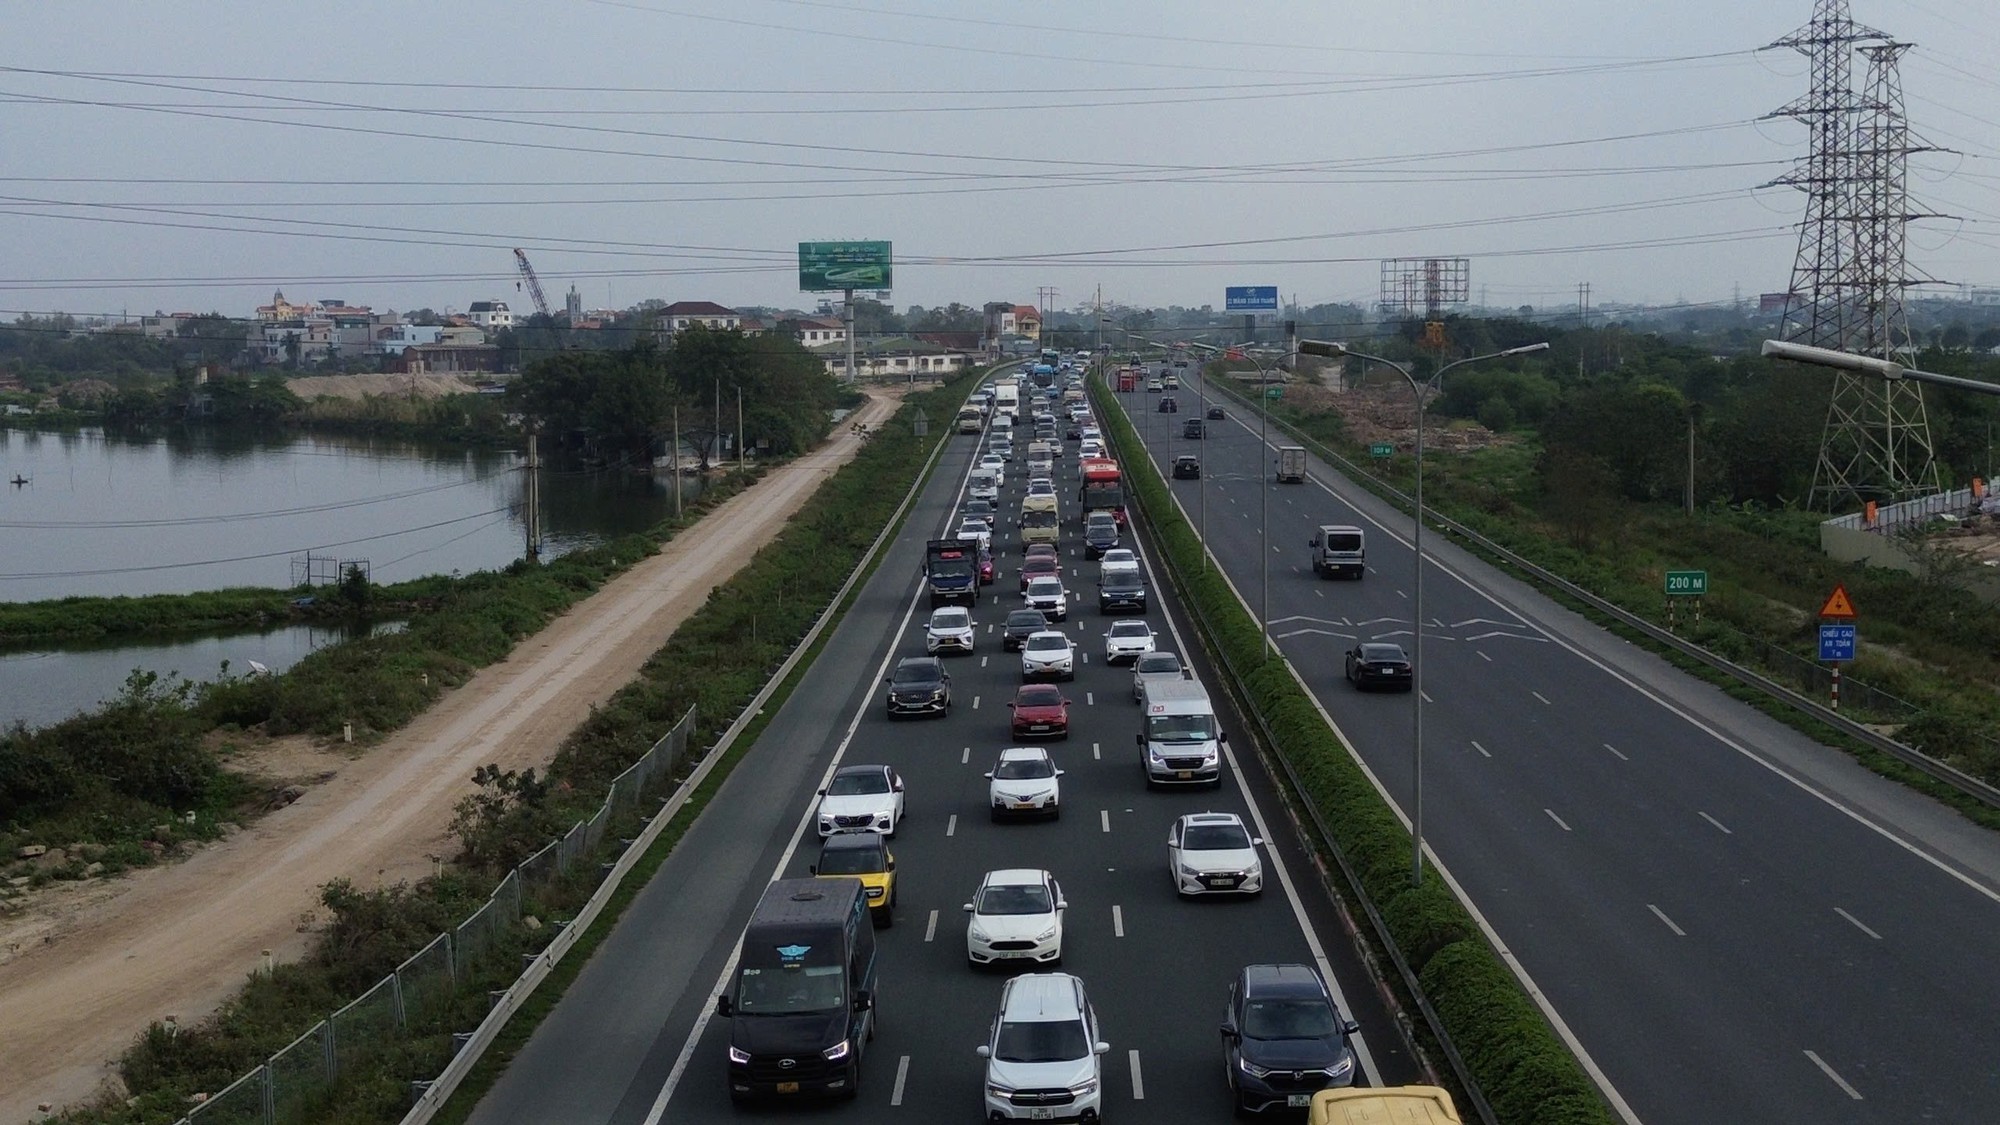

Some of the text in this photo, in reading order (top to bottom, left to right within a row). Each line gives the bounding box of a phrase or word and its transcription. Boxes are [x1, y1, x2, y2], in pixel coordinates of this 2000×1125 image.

[1669, 577, 1702, 589] 200 M
[1841, 630, 1853, 638] CAO
